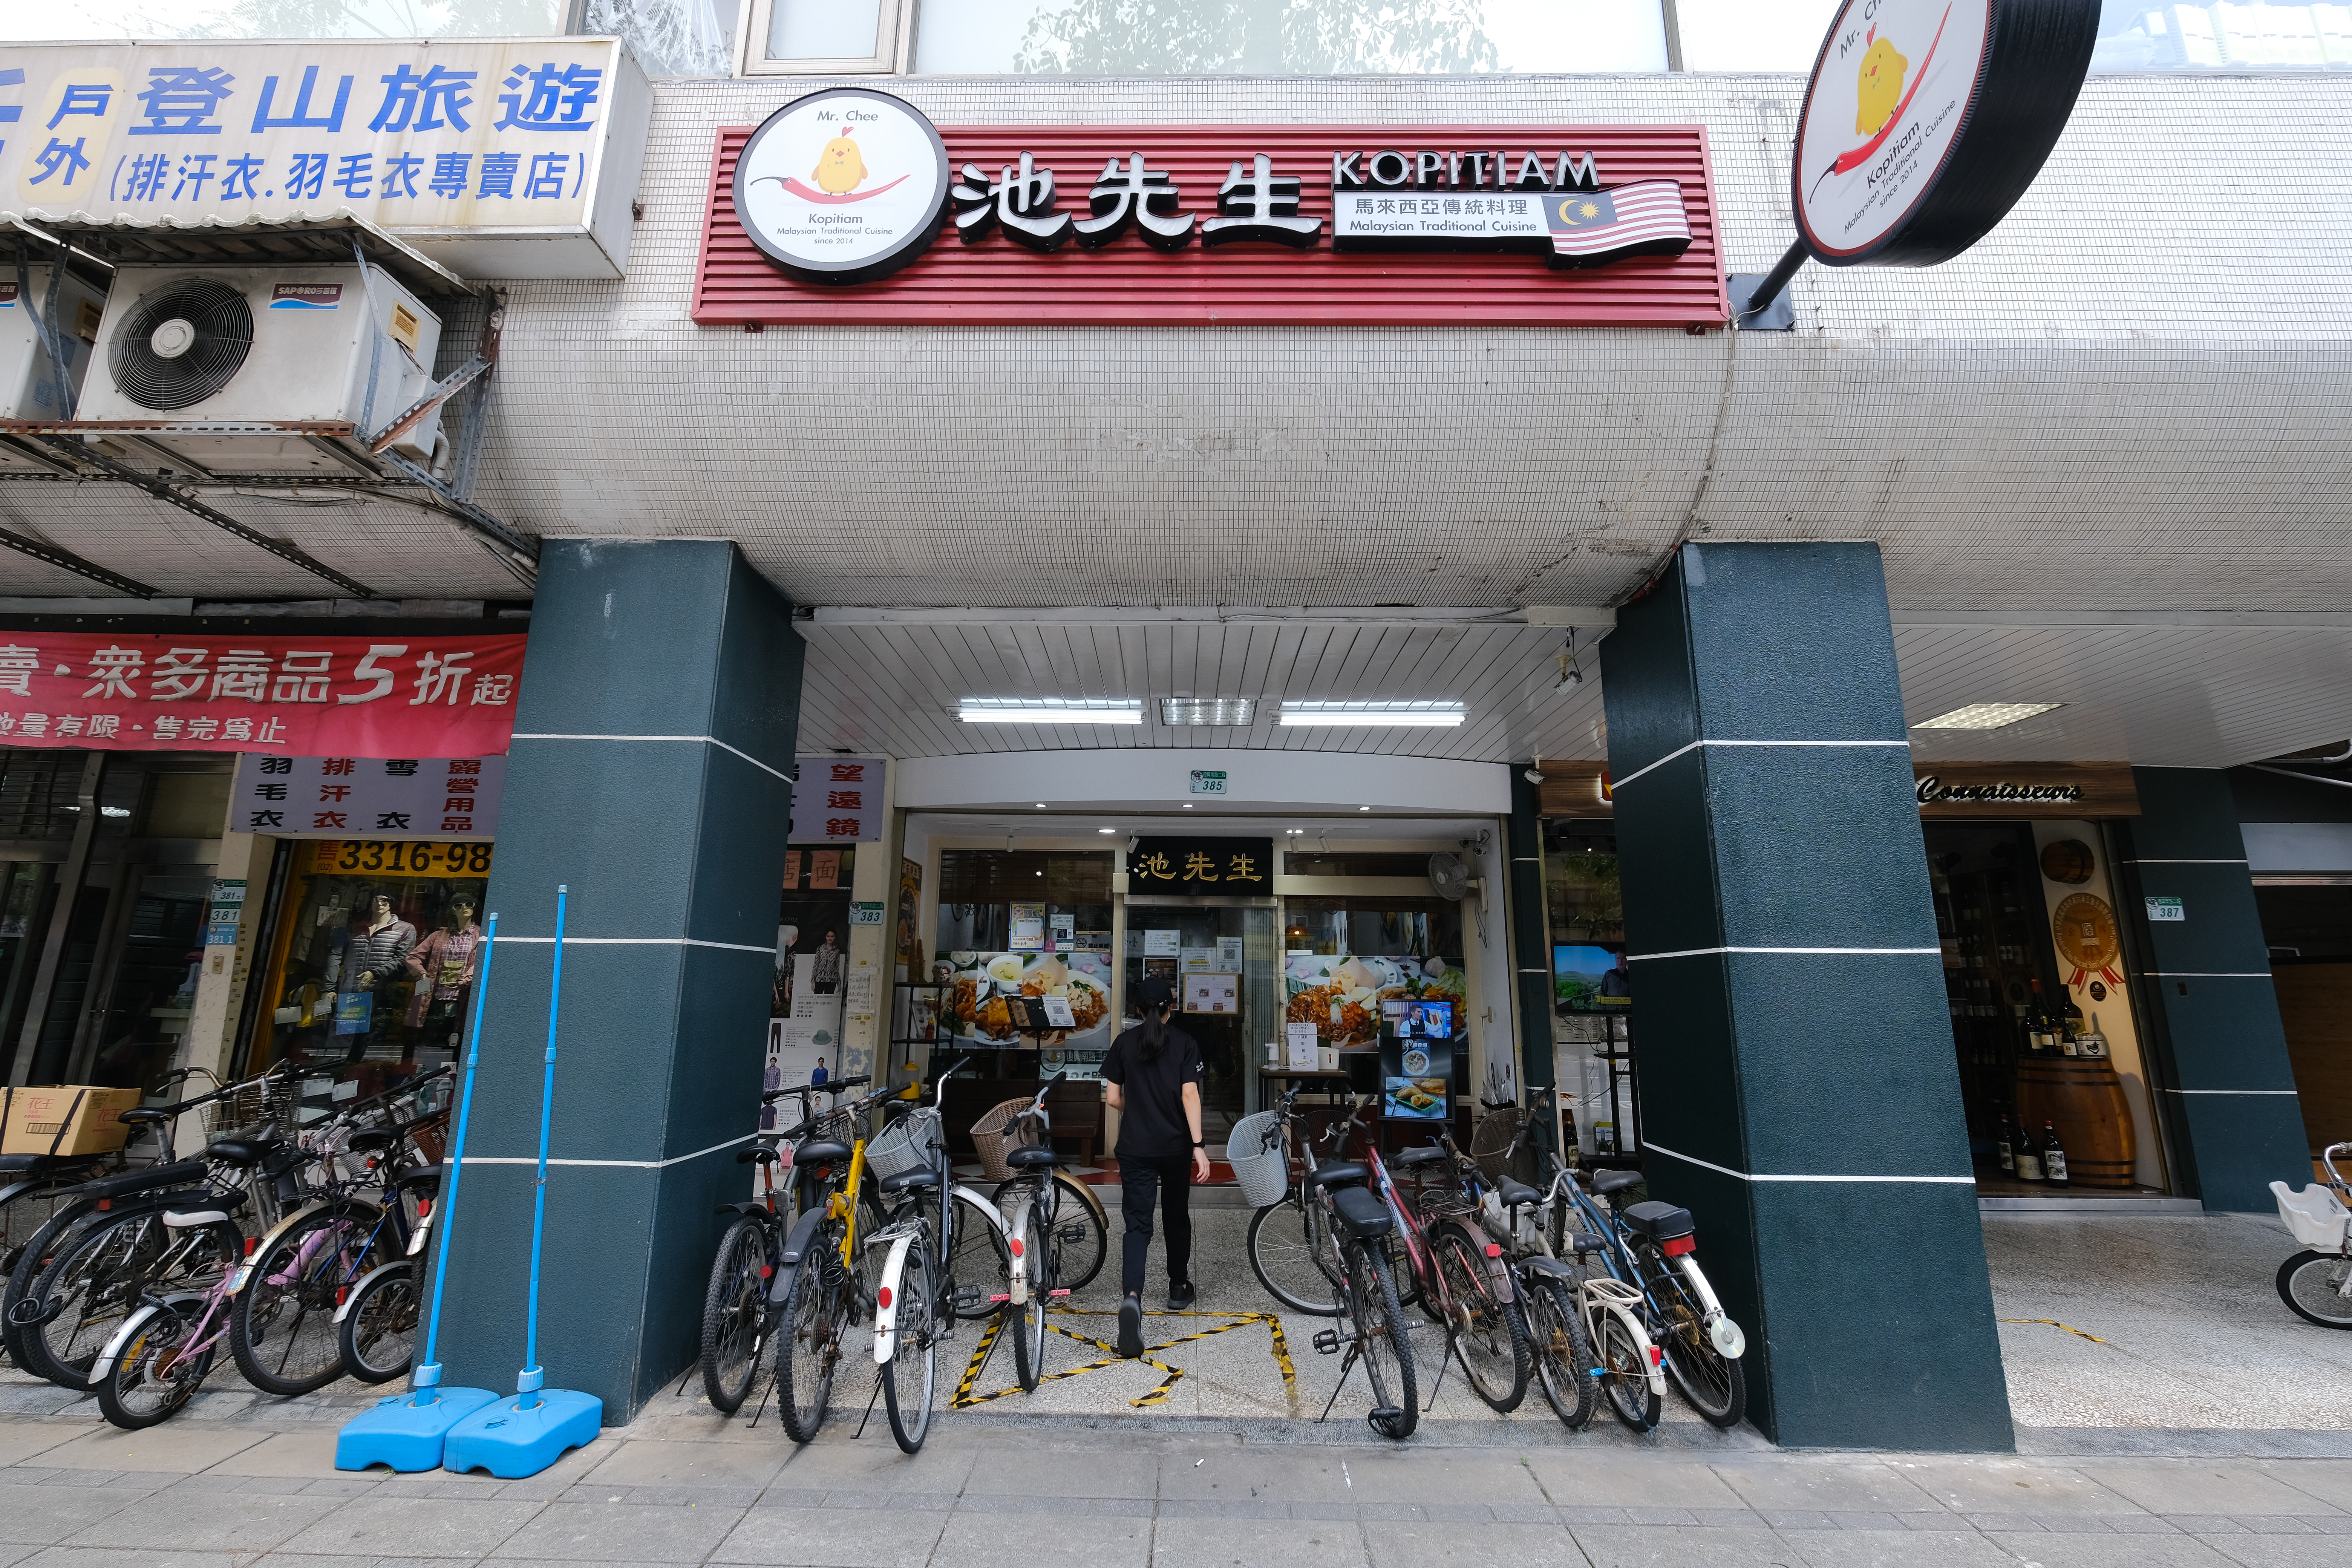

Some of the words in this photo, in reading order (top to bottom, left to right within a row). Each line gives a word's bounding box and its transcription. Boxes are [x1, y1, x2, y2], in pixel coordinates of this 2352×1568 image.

[1840, 30, 1860, 60] Mr.
[128, 63, 602, 135] 登山旅遊
[817, 111, 839, 121] Mr.
[846, 110, 879, 121] Chee
[29, 84, 114, 185] 戶外
[1333, 150, 1600, 189] KOPITIAM
[1844, 188, 1880, 234] Malaysian
[1882, 139, 1922, 189] Traditional
[1925, 100, 1956, 137] Cuisine
[1867, 121, 1920, 189] Kopitiam
[952, 152, 1323, 241] 池先生
[1879, 184, 1898, 208] since
[1900, 160, 1918, 183] 2014
[808, 213, 863, 226] Kopitiam
[1355, 198, 1528, 215] 馬來西亞傳統料理
[777, 227, 817, 236] Malaysian
[1350, 220, 1416, 233] Malaysian
[1420, 220, 1486, 232] Traditional
[1492, 220, 1537, 232] Cuisine
[250, 757, 293, 827] 羽毛衣
[313, 758, 355, 828] 排汗衣
[377, 758, 419, 829] 雪衣
[441, 760, 481, 831] 露營用品
[826, 764, 864, 836] 望遠鏡
[1203, 781, 1222, 790] 385
[1916, 776, 2084, 804] Connaisseurs
[317, 863, 333, 872] (02)
[339, 840, 492, 873] 3316-98
[1139, 851, 1262, 882] 池先生
[212, 910, 238, 920] 381
[861, 912, 880, 921] 383
[2160, 908, 2179, 917] 387
[208, 935, 233, 944] 381-1
[28, 1097, 55, 1110] 花王
